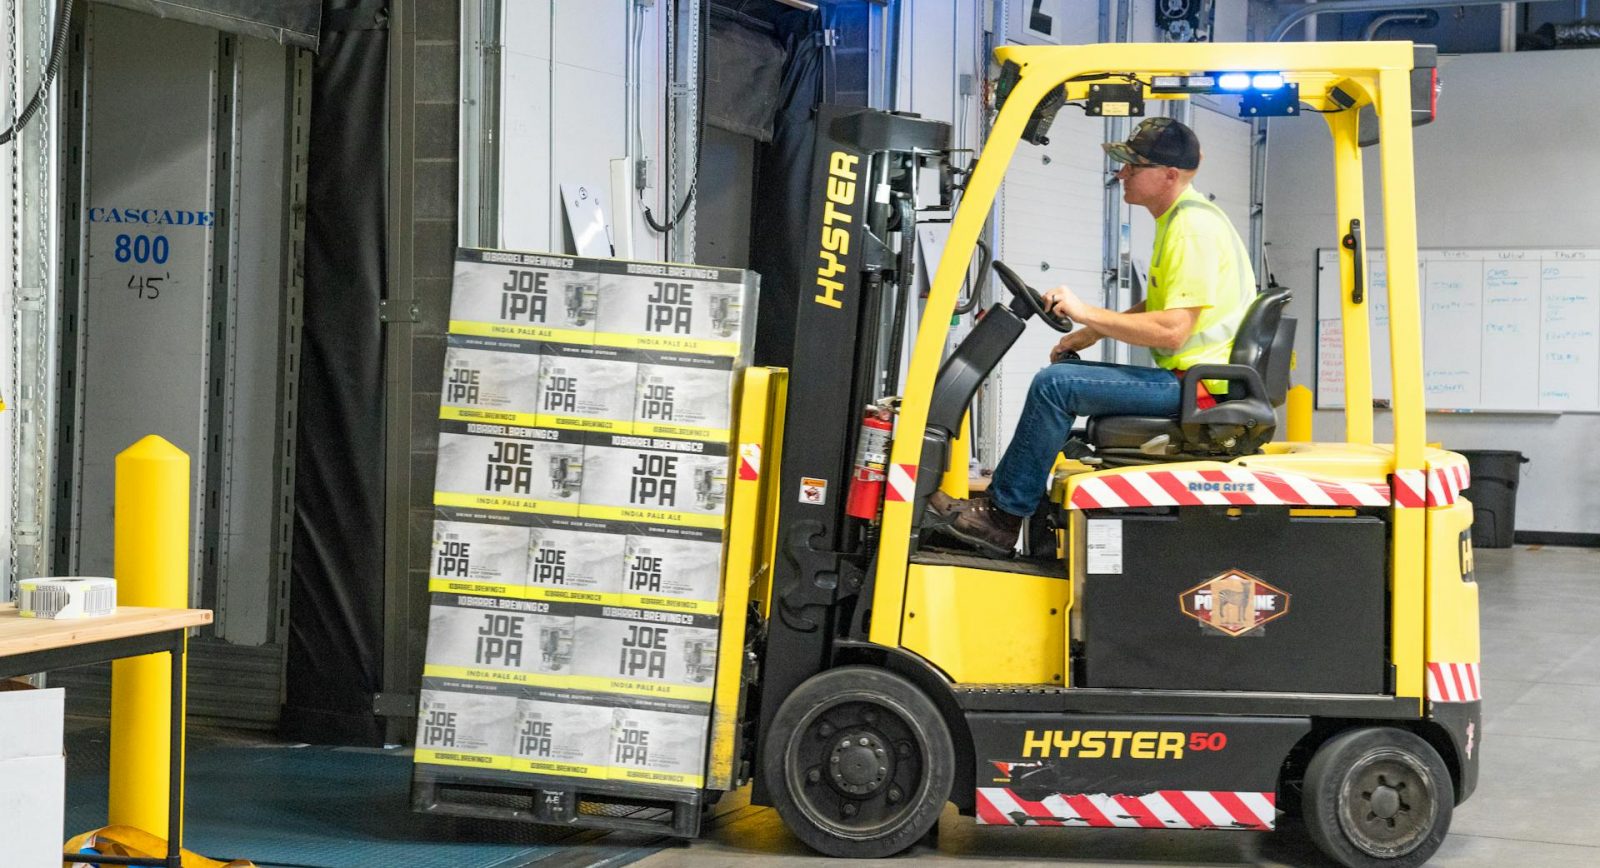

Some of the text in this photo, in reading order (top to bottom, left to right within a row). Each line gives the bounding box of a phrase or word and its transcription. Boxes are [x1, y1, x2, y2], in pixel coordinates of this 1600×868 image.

[90, 208, 214, 226] CASCADE
[815, 152, 858, 308] HYSTER
[115, 234, 169, 264] 800
[504, 270, 549, 294] JOE
[648, 282, 694, 305] JOE
[501, 293, 547, 322] IPA
[646, 305, 692, 334] IPA
[449, 369, 480, 385] JOE
[546, 376, 577, 392] JOE
[448, 384, 479, 404] IPA
[544, 392, 576, 412] IPA
[644, 385, 674, 401] JOE
[642, 400, 673, 420] IPA
[488, 442, 534, 465] JOE
[632, 454, 678, 478] JOE
[486, 464, 532, 494] IPA
[1189, 482, 1220, 491] RIDE
[630, 476, 676, 507] IPA
[439, 542, 470, 557] JOE
[535, 549, 566, 565] JOE
[438, 557, 469, 577] IPA
[533, 564, 564, 584] IPA
[632, 556, 662, 572] JOE
[629, 571, 660, 592] IPA
[479, 614, 524, 638] JOE
[622, 625, 668, 650] JOE
[476, 637, 522, 666] IPA
[620, 648, 666, 678] IPA
[426, 711, 457, 727] JOE
[522, 721, 552, 737] JOE
[424, 727, 456, 747] IPA
[520, 736, 551, 757] IPA
[618, 729, 649, 745] JOE
[1022, 730, 1226, 759] HYSTER 50
[616, 744, 648, 765] IPA
